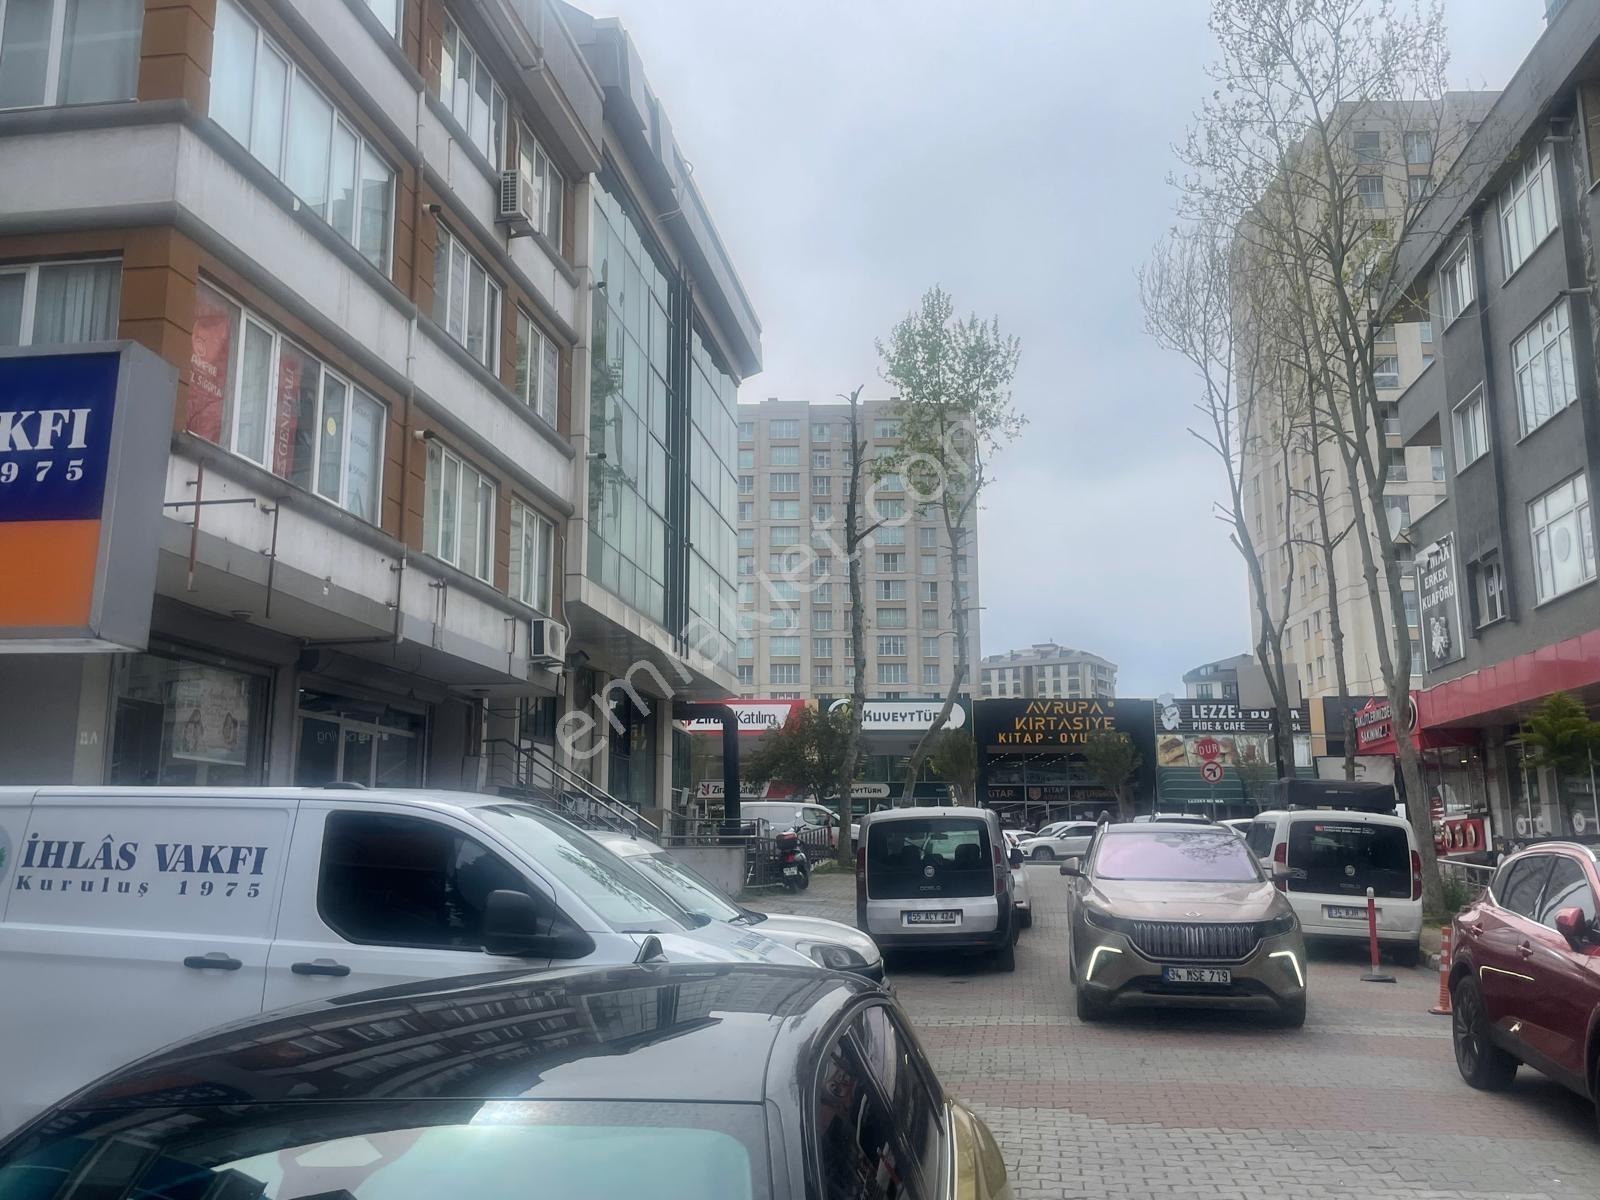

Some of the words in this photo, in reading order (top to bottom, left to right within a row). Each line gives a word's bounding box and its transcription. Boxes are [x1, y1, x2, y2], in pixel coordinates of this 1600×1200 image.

[1424, 566, 1448, 590] ERKEK
[1025, 701, 1104, 715] AVRUPA
[735, 710, 776, 725] Katılım
[1223, 722, 1246, 731] CAFE
[1198, 743, 1219, 756] DUR
[20, 832, 139, 871] İHLÂS
[154, 843, 269, 876] VAKFI
[15, 875, 149, 897] Kuruluş
[178, 880, 261, 899] 1975
[1168, 967, 1182, 980] 34
